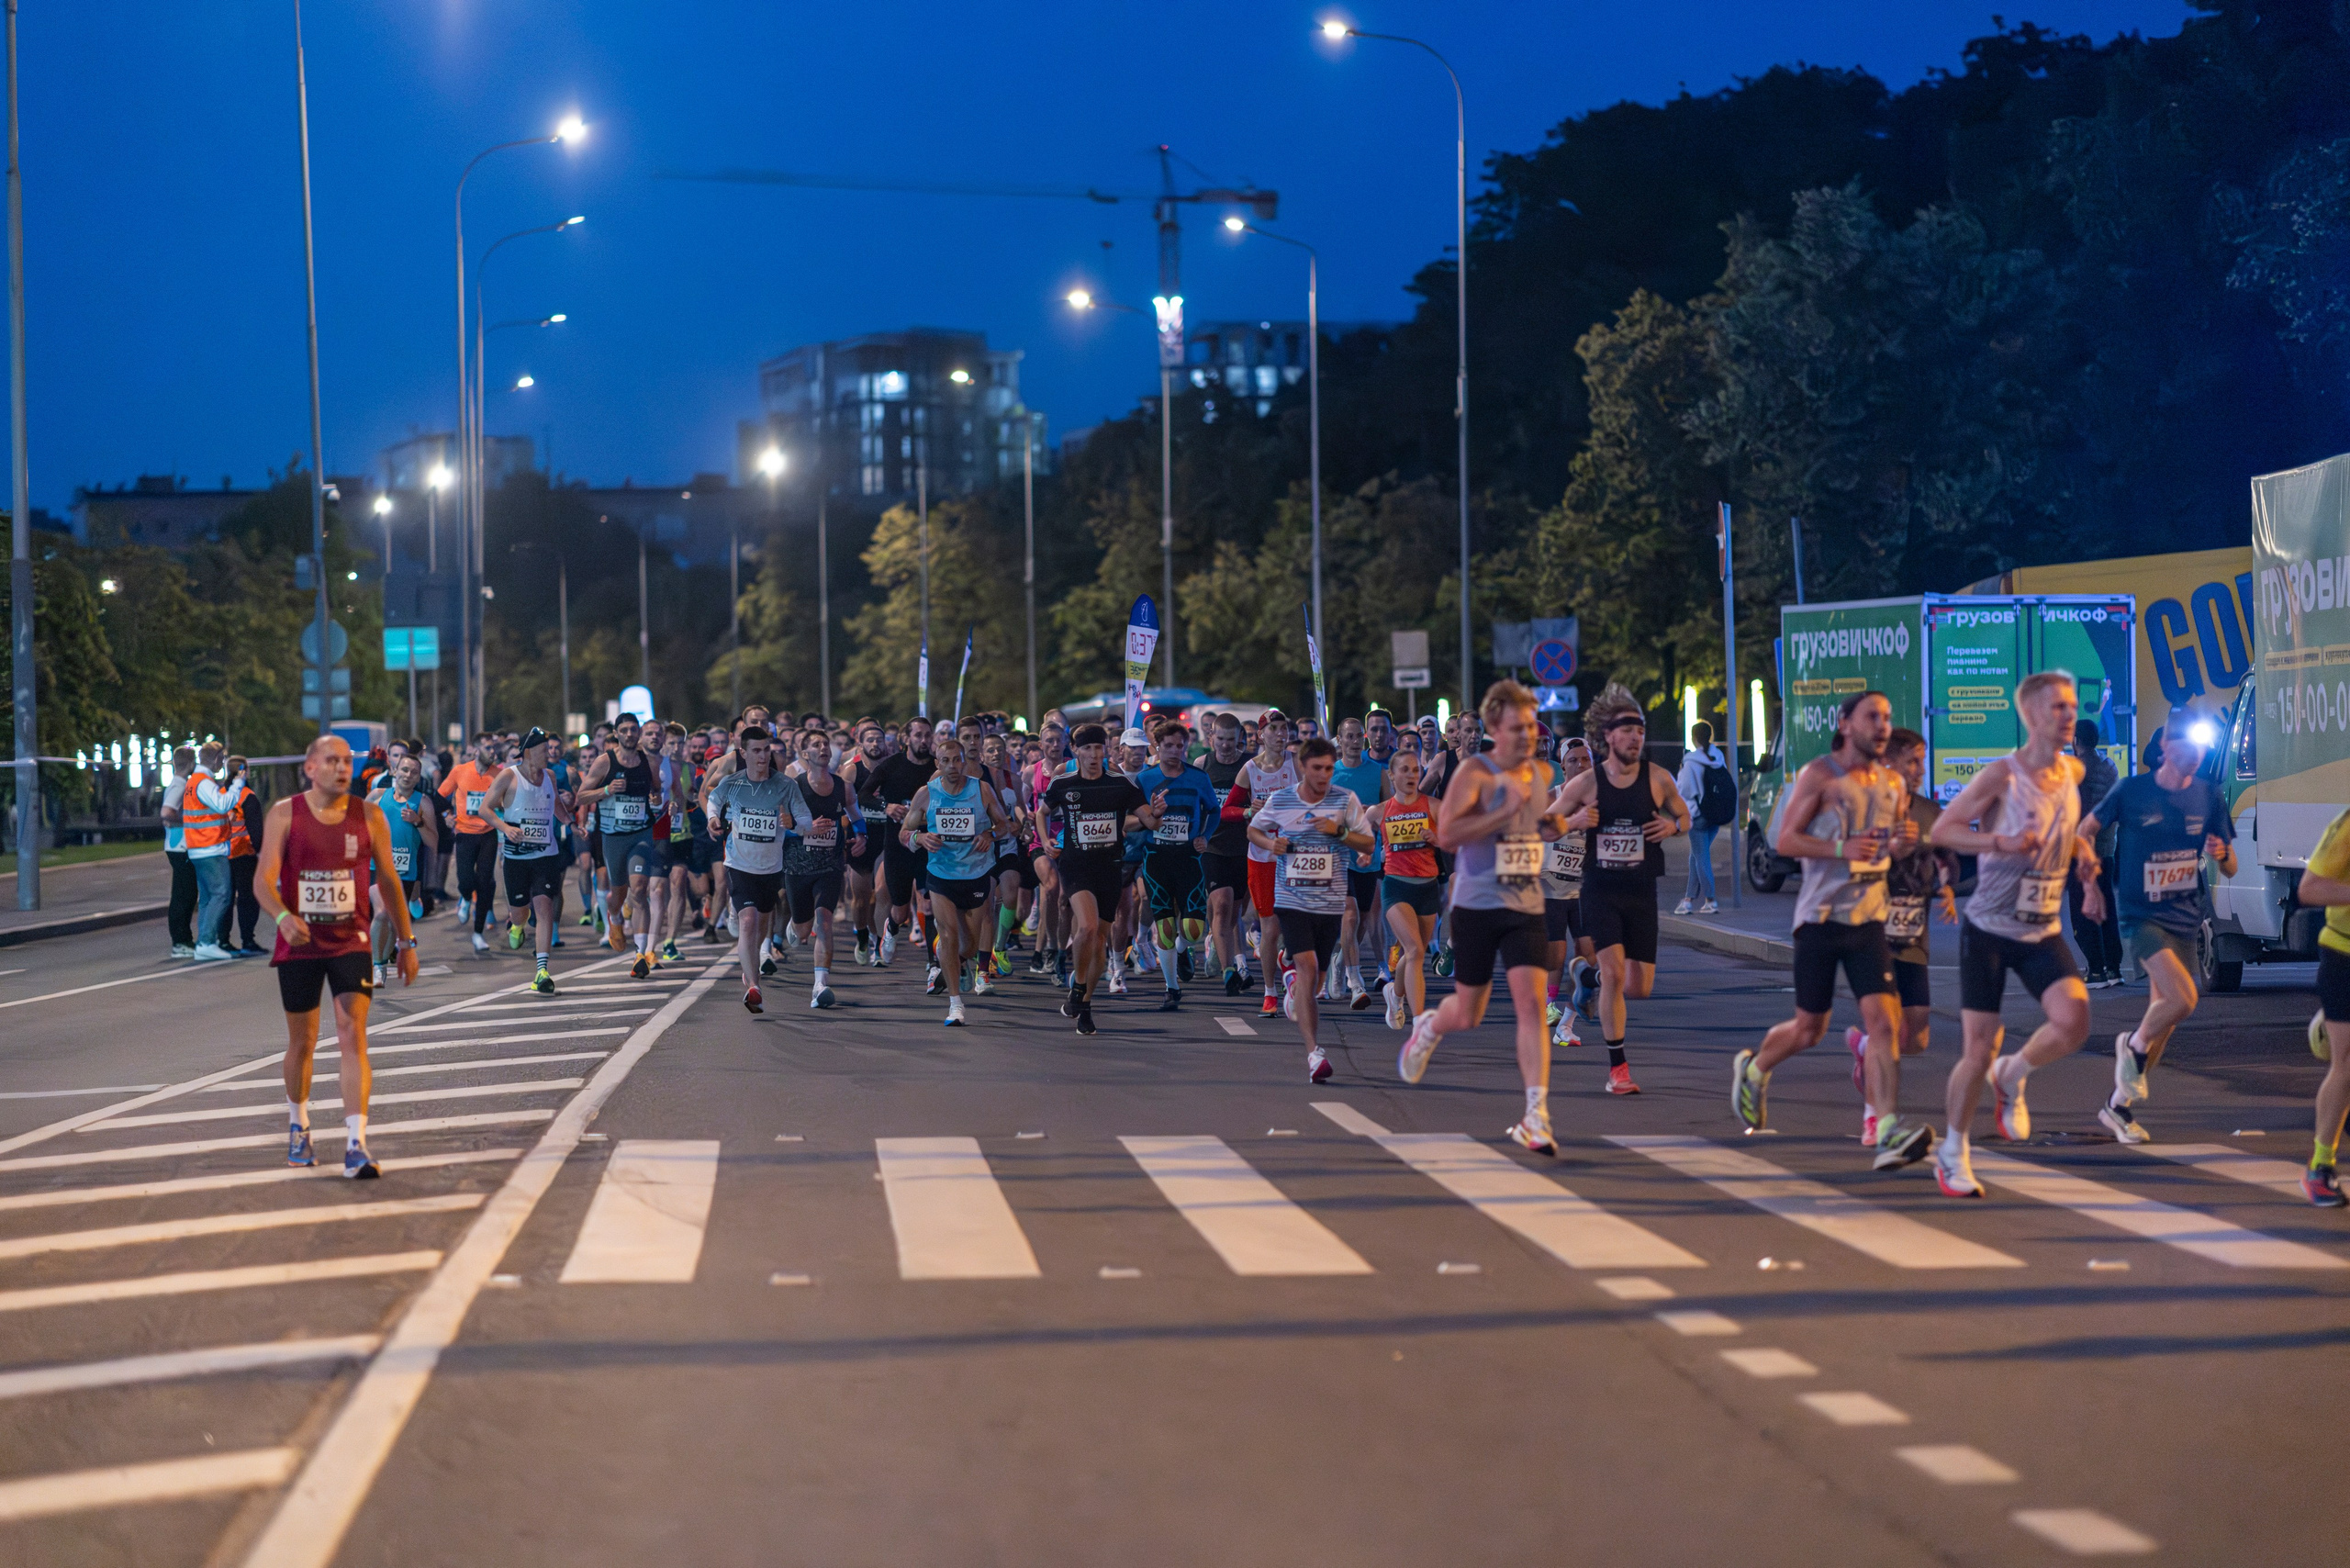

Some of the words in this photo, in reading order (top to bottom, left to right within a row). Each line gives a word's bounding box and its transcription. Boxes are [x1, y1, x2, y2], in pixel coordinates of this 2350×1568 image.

[1947, 646, 1998, 656] Перевезем
[1947, 657, 1987, 666] пианино
[1947, 667, 1964, 676] как
[2277, 681, 2350, 734] 150-00-0
[622, 804, 641, 815] 603
[742, 816, 776, 830] 10816
[941, 817, 969, 829] 8929
[1083, 823, 1113, 836] 8646
[1392, 822, 1424, 836] 2627
[524, 826, 548, 837] 8250
[1603, 839, 1638, 853] 9572
[1292, 857, 1326, 871] 4288
[2148, 866, 2195, 887] 17679
[305, 886, 348, 903] 3216
